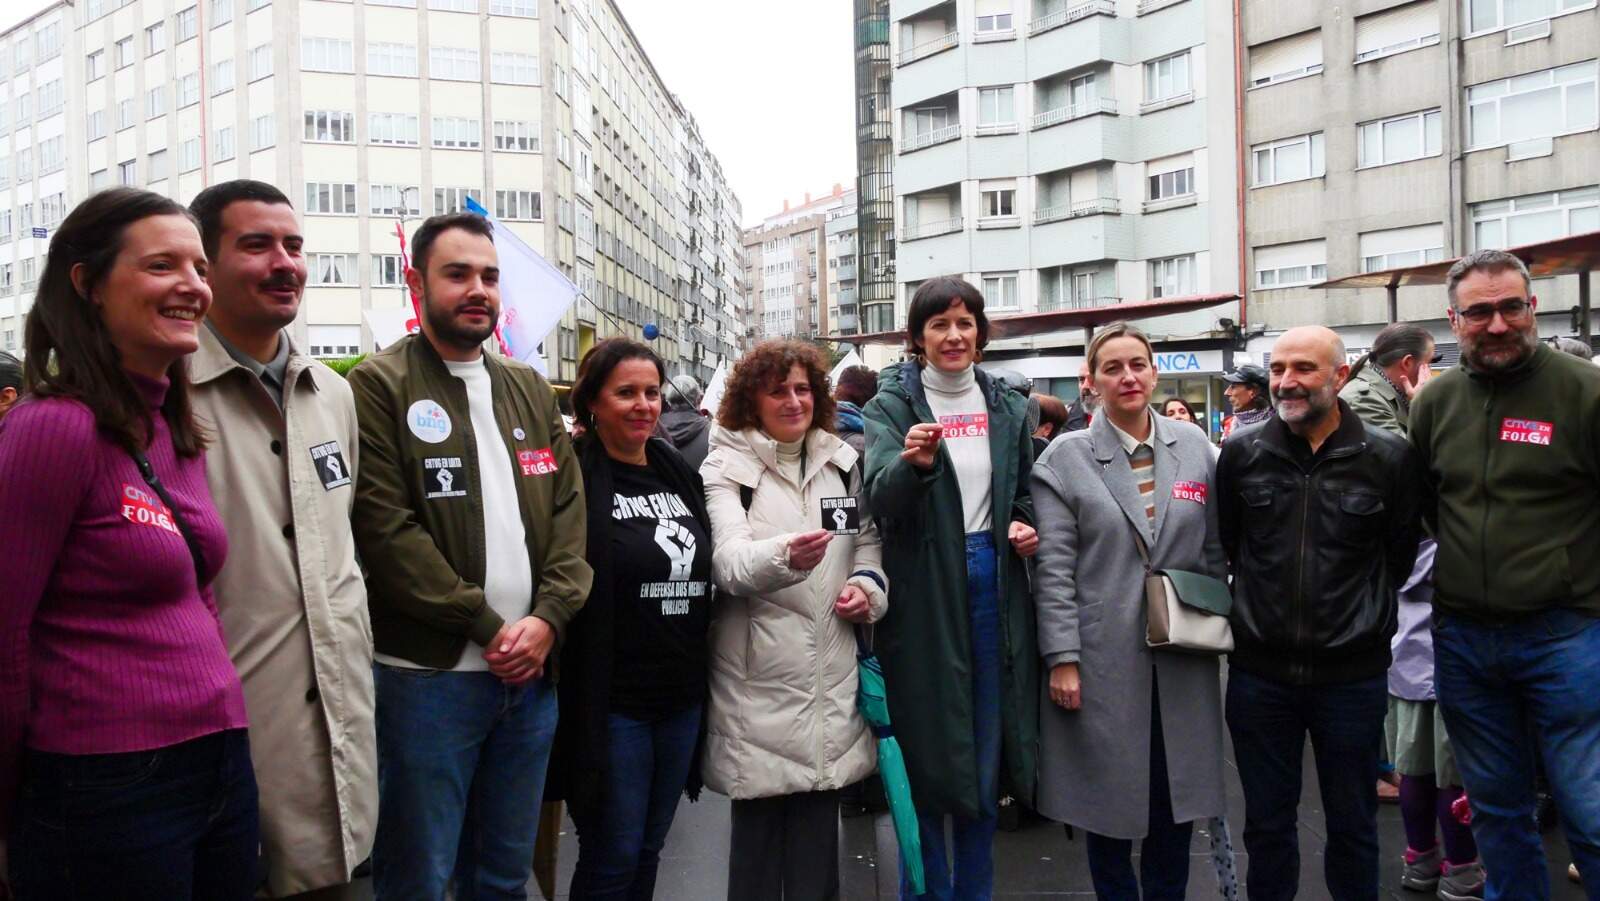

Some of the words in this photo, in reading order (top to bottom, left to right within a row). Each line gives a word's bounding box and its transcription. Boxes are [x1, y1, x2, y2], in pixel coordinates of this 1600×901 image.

[1157, 353, 1201, 371] NCA
[416, 411, 446, 433] bng
[942, 424, 987, 438] FOLGA
[1500, 430, 1550, 446] FOLGA
[640, 583, 649, 598] EN
[649, 582, 675, 598] DEFENSA
[675, 582, 687, 597] DOS
